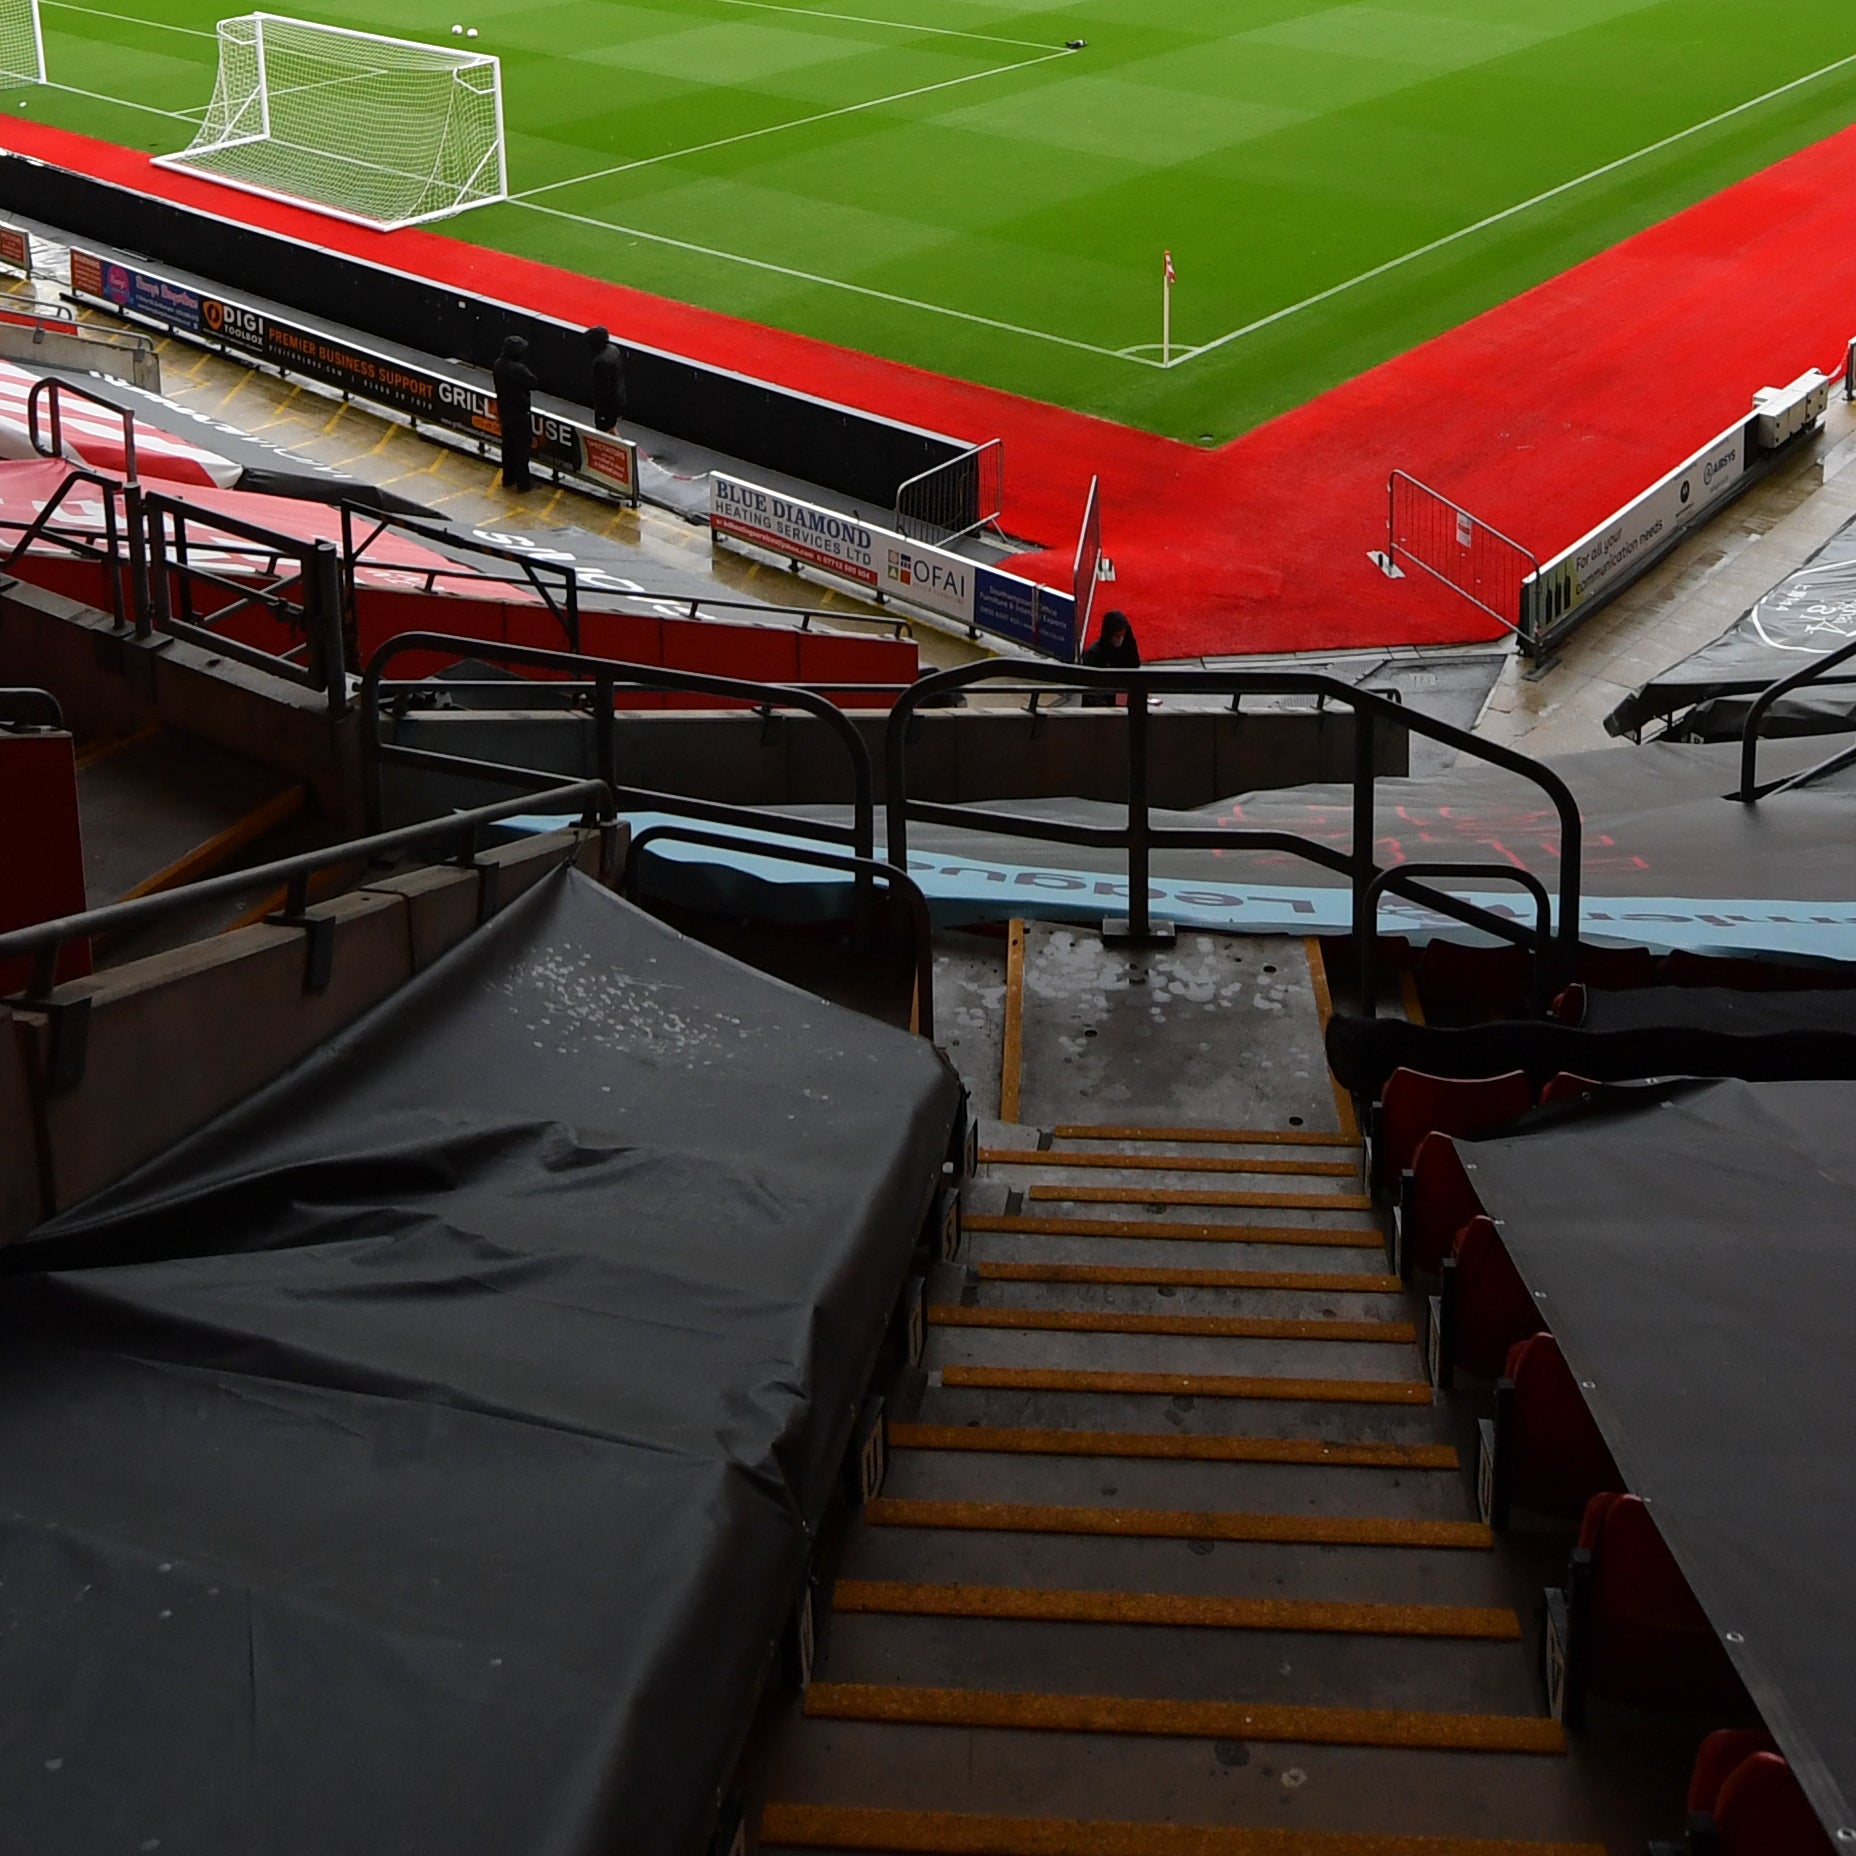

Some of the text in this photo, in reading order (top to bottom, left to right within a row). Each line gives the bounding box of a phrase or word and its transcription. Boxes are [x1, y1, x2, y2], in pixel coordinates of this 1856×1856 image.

[223, 305, 264, 336] DIGI
[224, 324, 263, 346] TOOLBOX
[267, 327, 434, 399] PREMIER BUSINESS SUPPORT
[1712, 449, 1736, 474] AIRSYS
[715, 479, 872, 550] BLUE DIAMOND
[715, 500, 872, 567] HEATING SERVICES LTD
[1575, 528, 1623, 572] For all your
[1575, 518, 1664, 596] communication needs
[913, 559, 966, 598] OFAI
